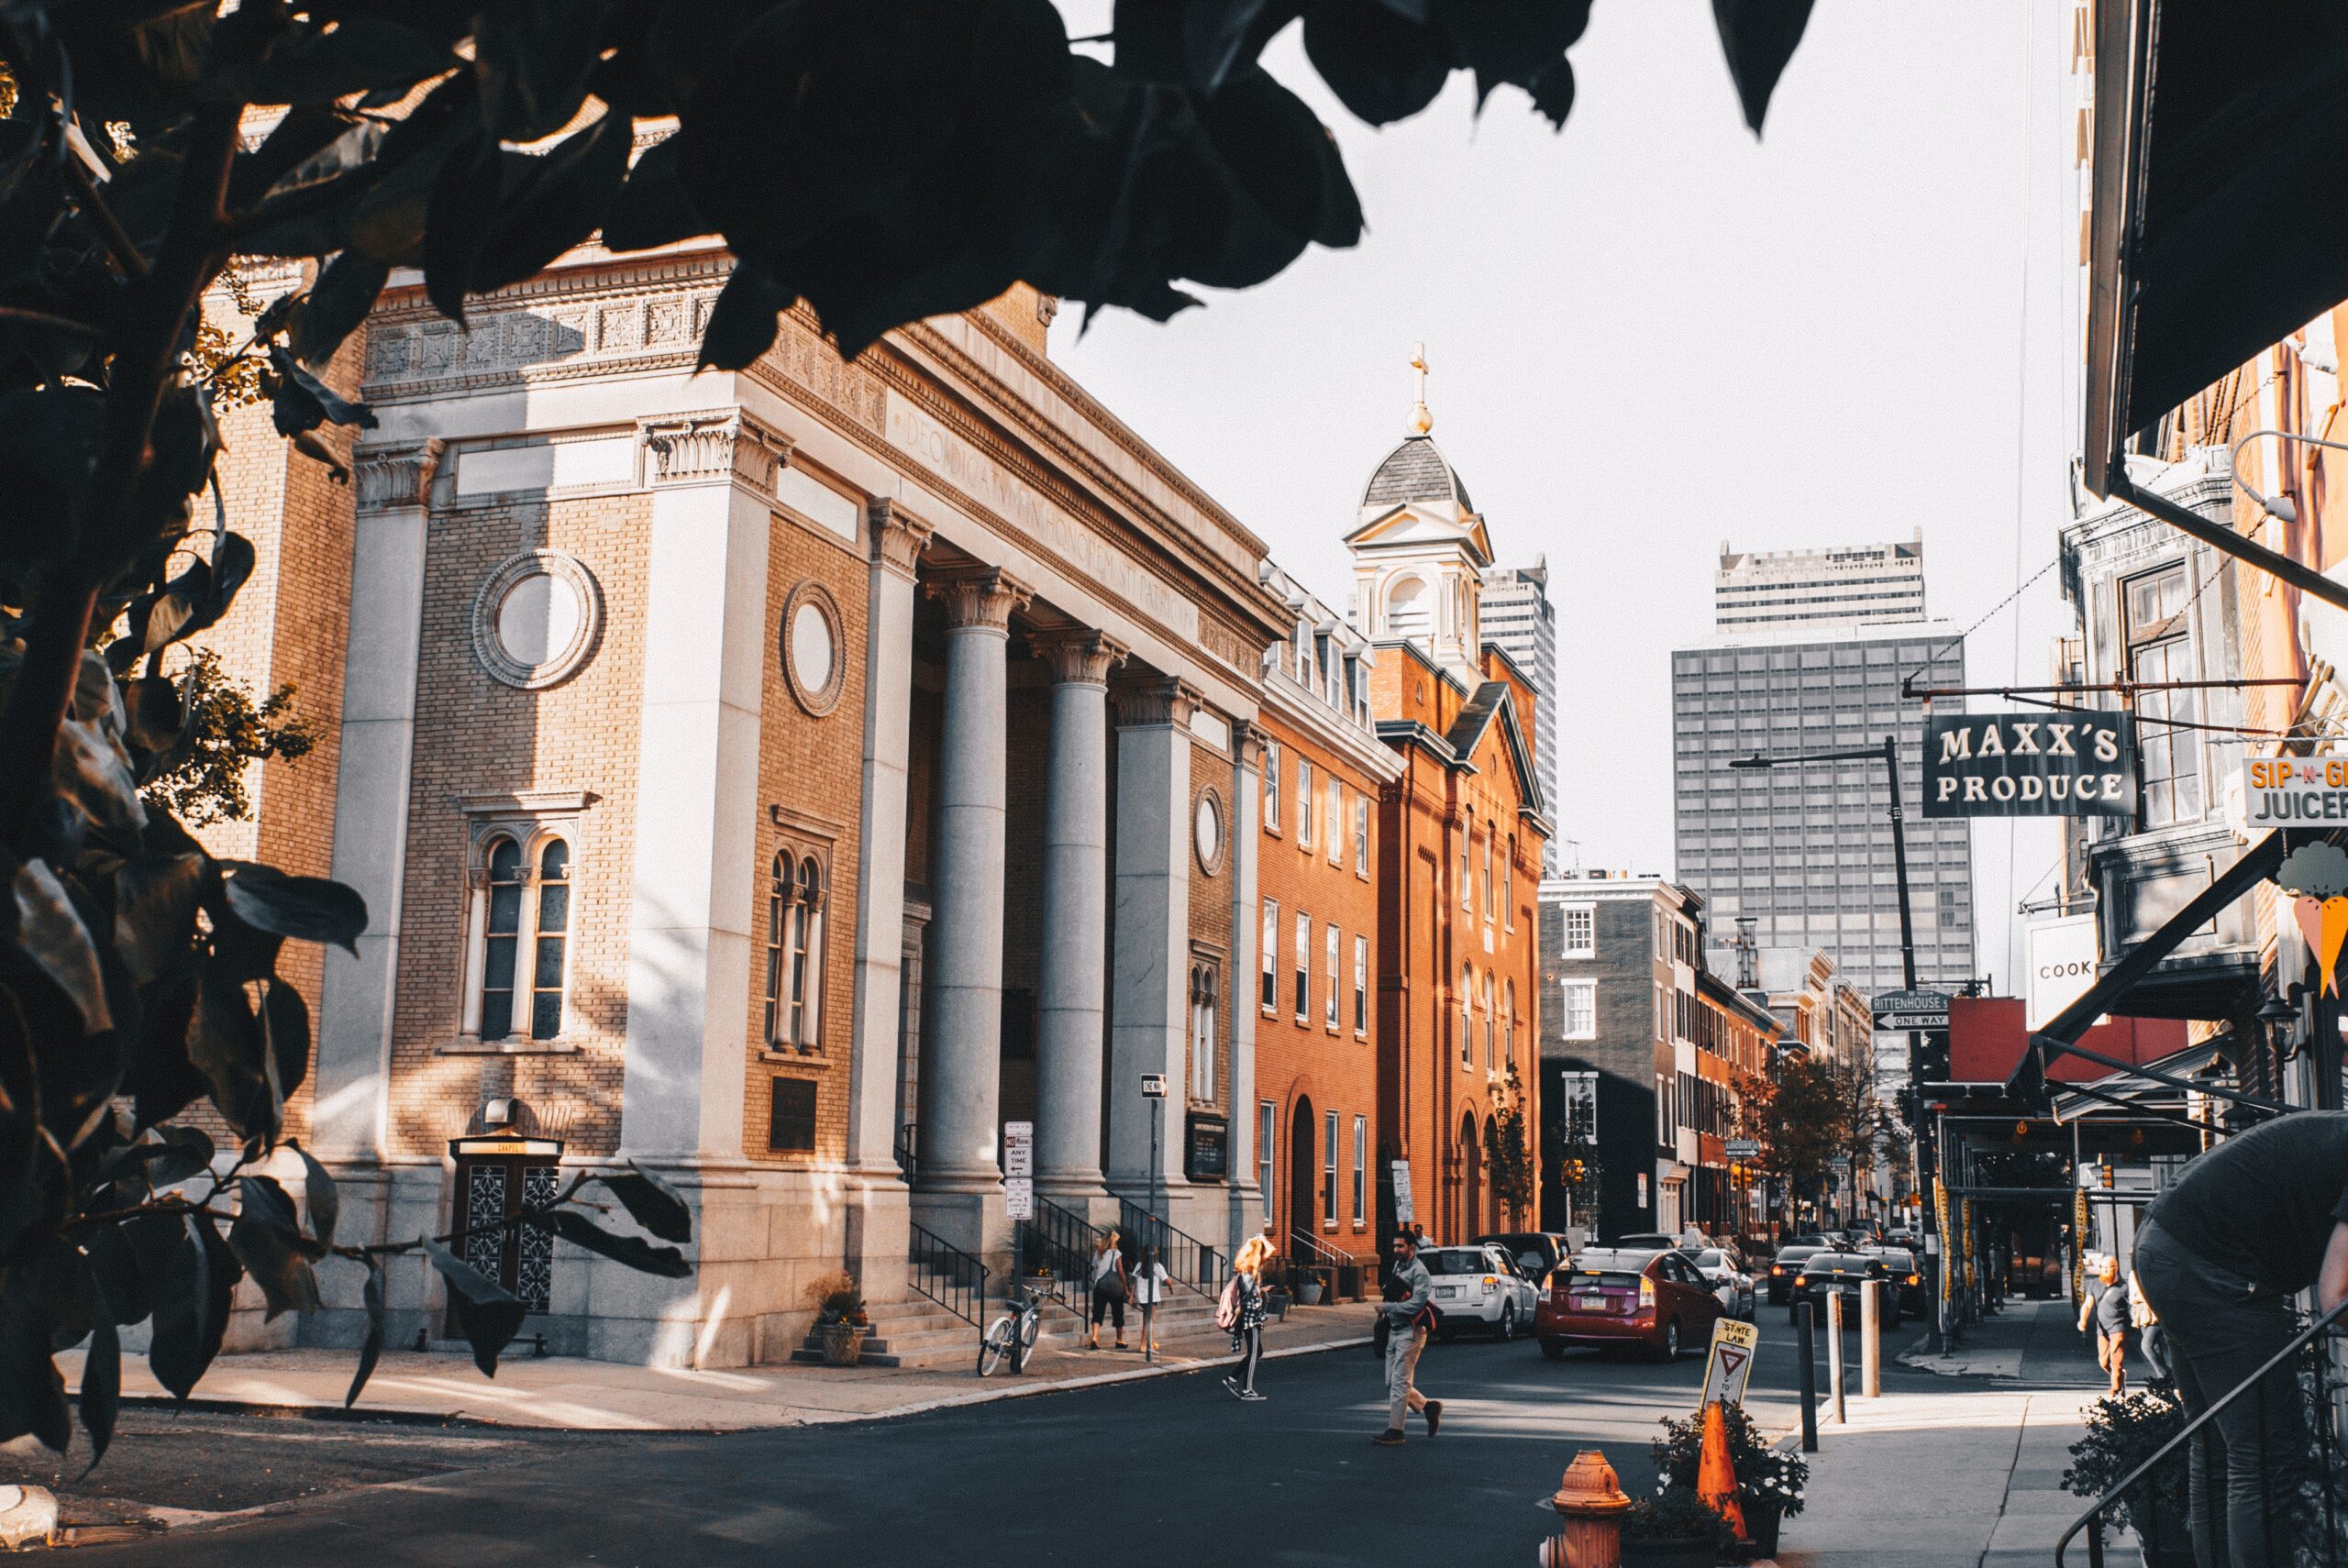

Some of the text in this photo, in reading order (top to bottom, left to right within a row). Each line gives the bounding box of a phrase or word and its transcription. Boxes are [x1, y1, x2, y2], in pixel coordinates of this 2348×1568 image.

[1936, 774, 2123, 802] PRODUCE
[2040, 960, 2092, 979] COOK
[1874, 997, 1941, 1010] RITTENHOUSE
[1895, 1016, 1944, 1025] ONE WAY
[498, 1143, 519, 1153] CHAPEL
[1724, 1322, 1751, 1336] STATE
[1725, 1333, 1744, 1344] LAW
[1722, 1383, 1730, 1391] TO
